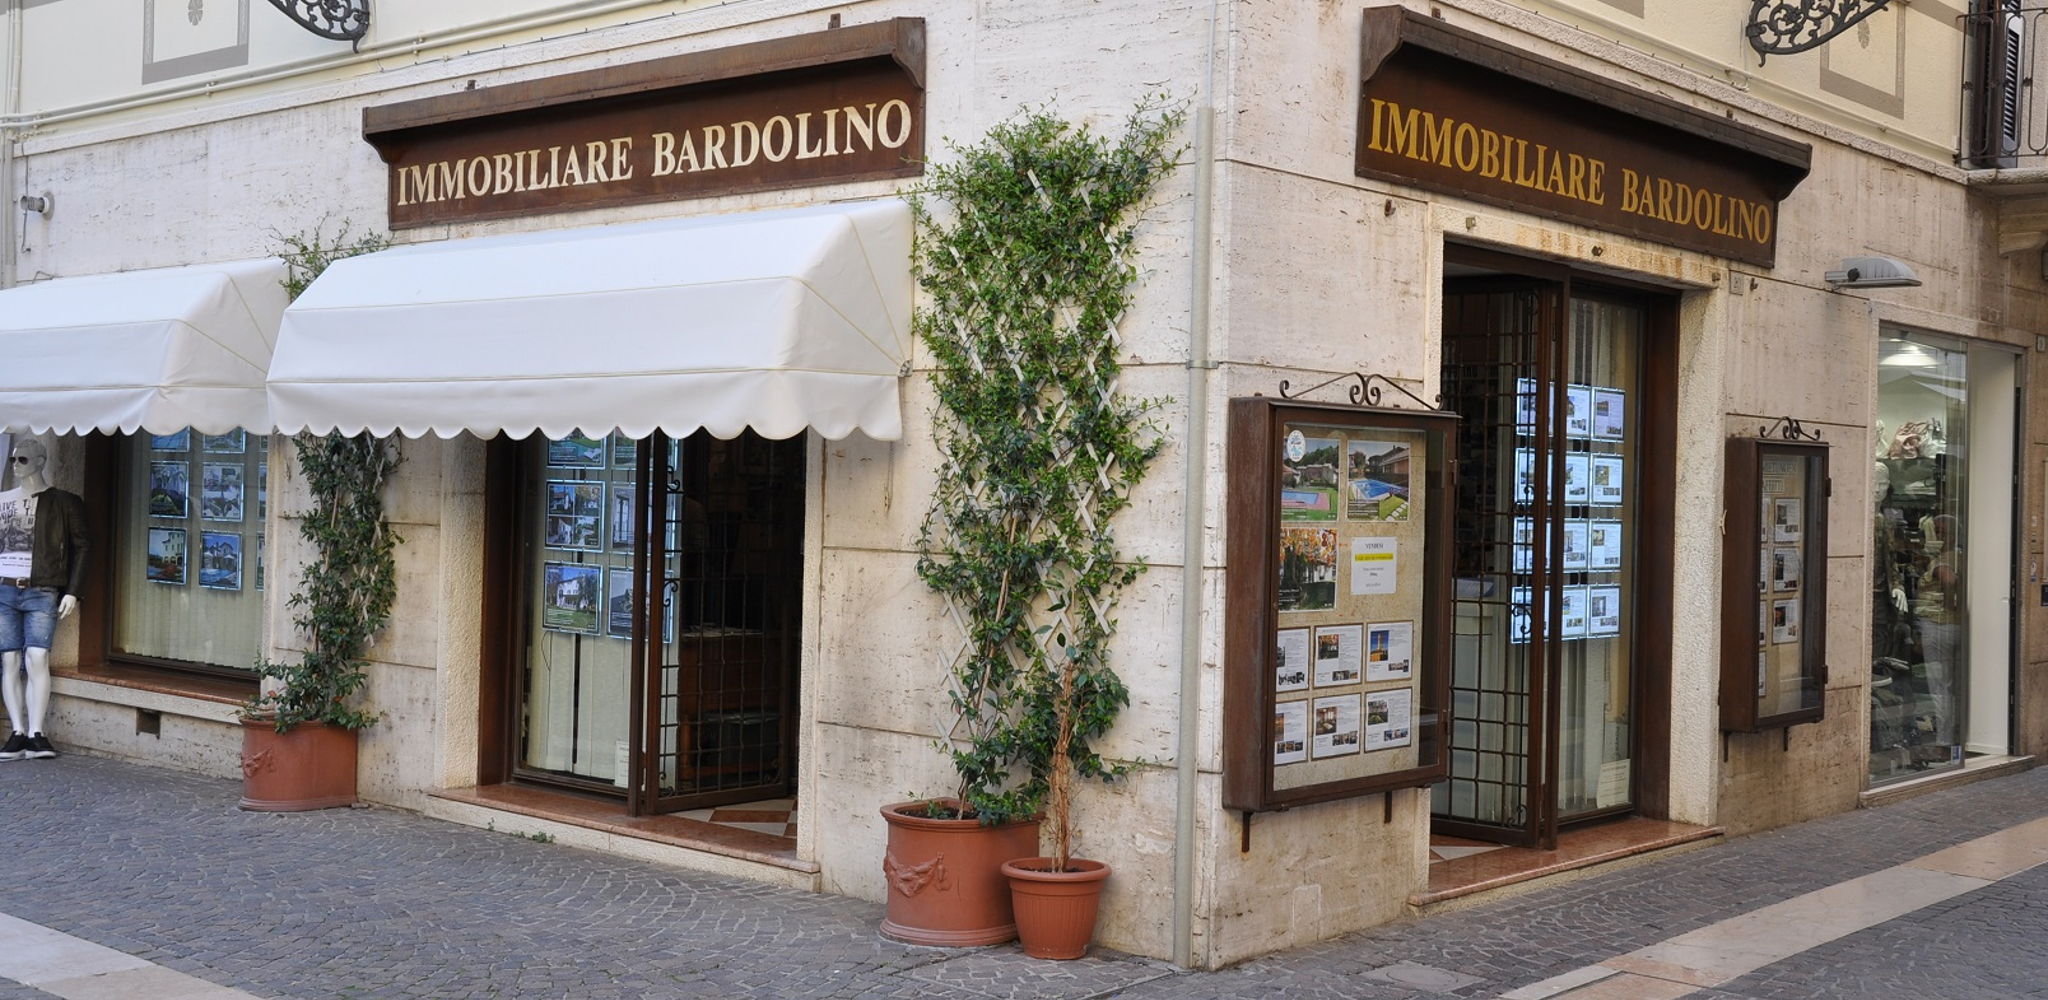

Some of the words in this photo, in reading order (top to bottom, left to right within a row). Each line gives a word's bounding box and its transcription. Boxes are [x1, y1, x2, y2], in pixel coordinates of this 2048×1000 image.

[397, 137, 634, 206] IMMOBILIARE
[652, 99, 912, 177] BARDOLINO
[1368, 98, 1605, 206] IMMOBILIARE
[1620, 168, 1771, 244] BARDOLINO
